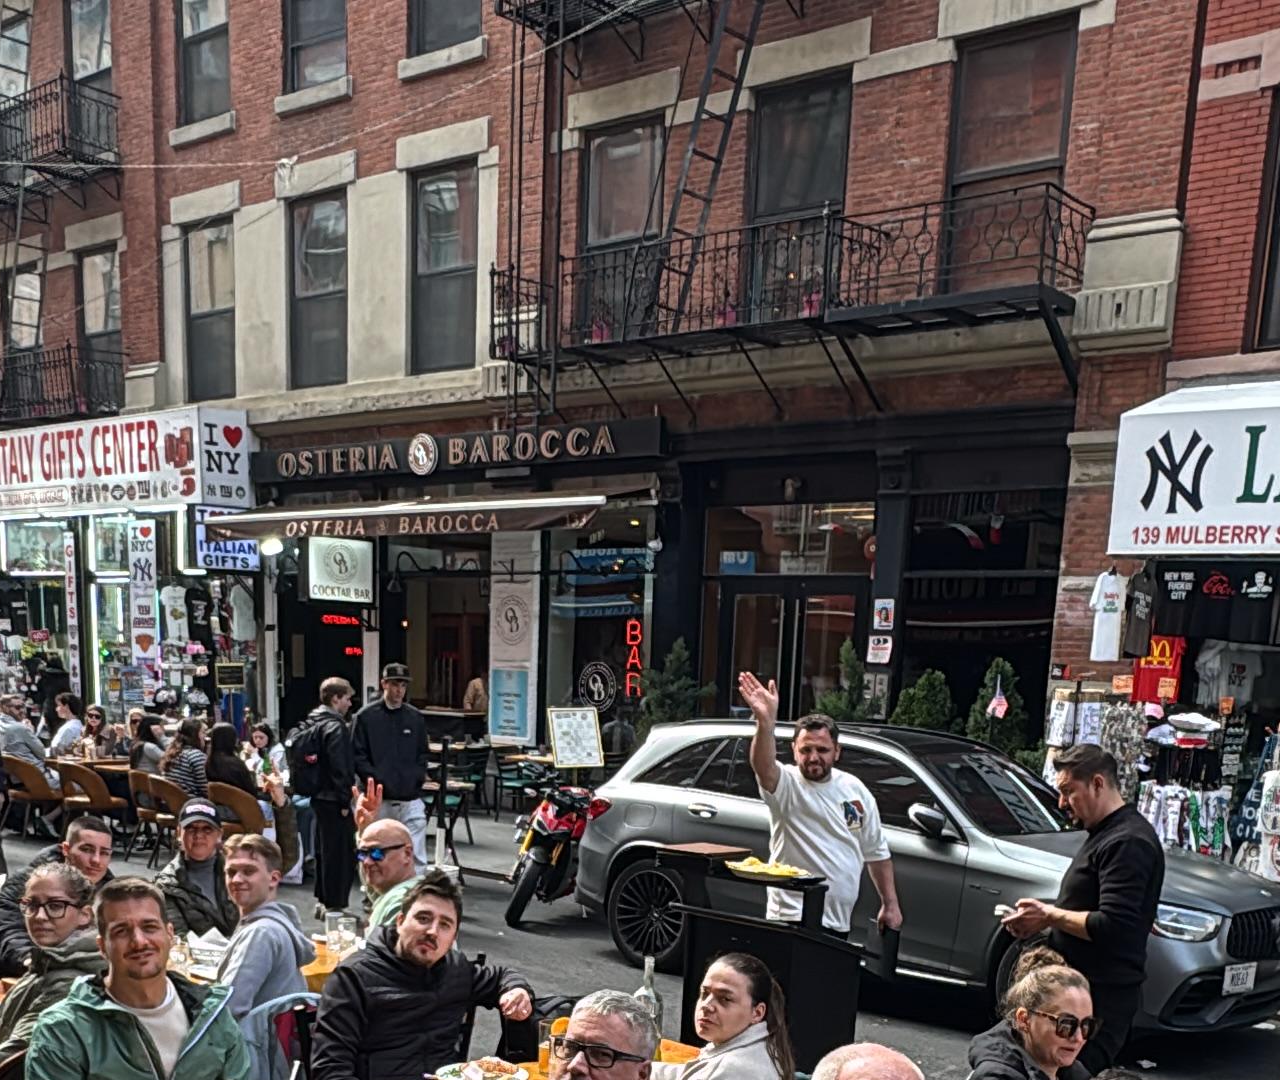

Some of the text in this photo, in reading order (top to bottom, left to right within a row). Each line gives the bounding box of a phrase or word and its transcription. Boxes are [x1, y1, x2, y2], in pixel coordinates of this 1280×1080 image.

[204, 422, 219, 446] I
[39, 425, 86, 482] GIFTS
[90, 419, 160, 477] CENTER
[277, 425, 616, 478] OSTERIA BAROCCA
[204, 449, 241, 476] NY
[130, 526, 139, 538] I
[284, 518, 367, 538] OSTERIA
[398, 513, 500, 535] BAROCCA
[1131, 526, 1160, 545] 139
[1164, 524, 1271, 545] MULBERRY
[130, 540, 154, 553] NYC
[199, 540, 258, 556] ITALIAN
[203, 553, 250, 569] GIFTS
[64, 544, 76, 619] GIFTS
[354, 587, 371, 601] BAR
[1170, 590, 1187, 600] CITY
[625, 618, 643, 699] BAR
[1236, 823, 1259, 840] CIT
